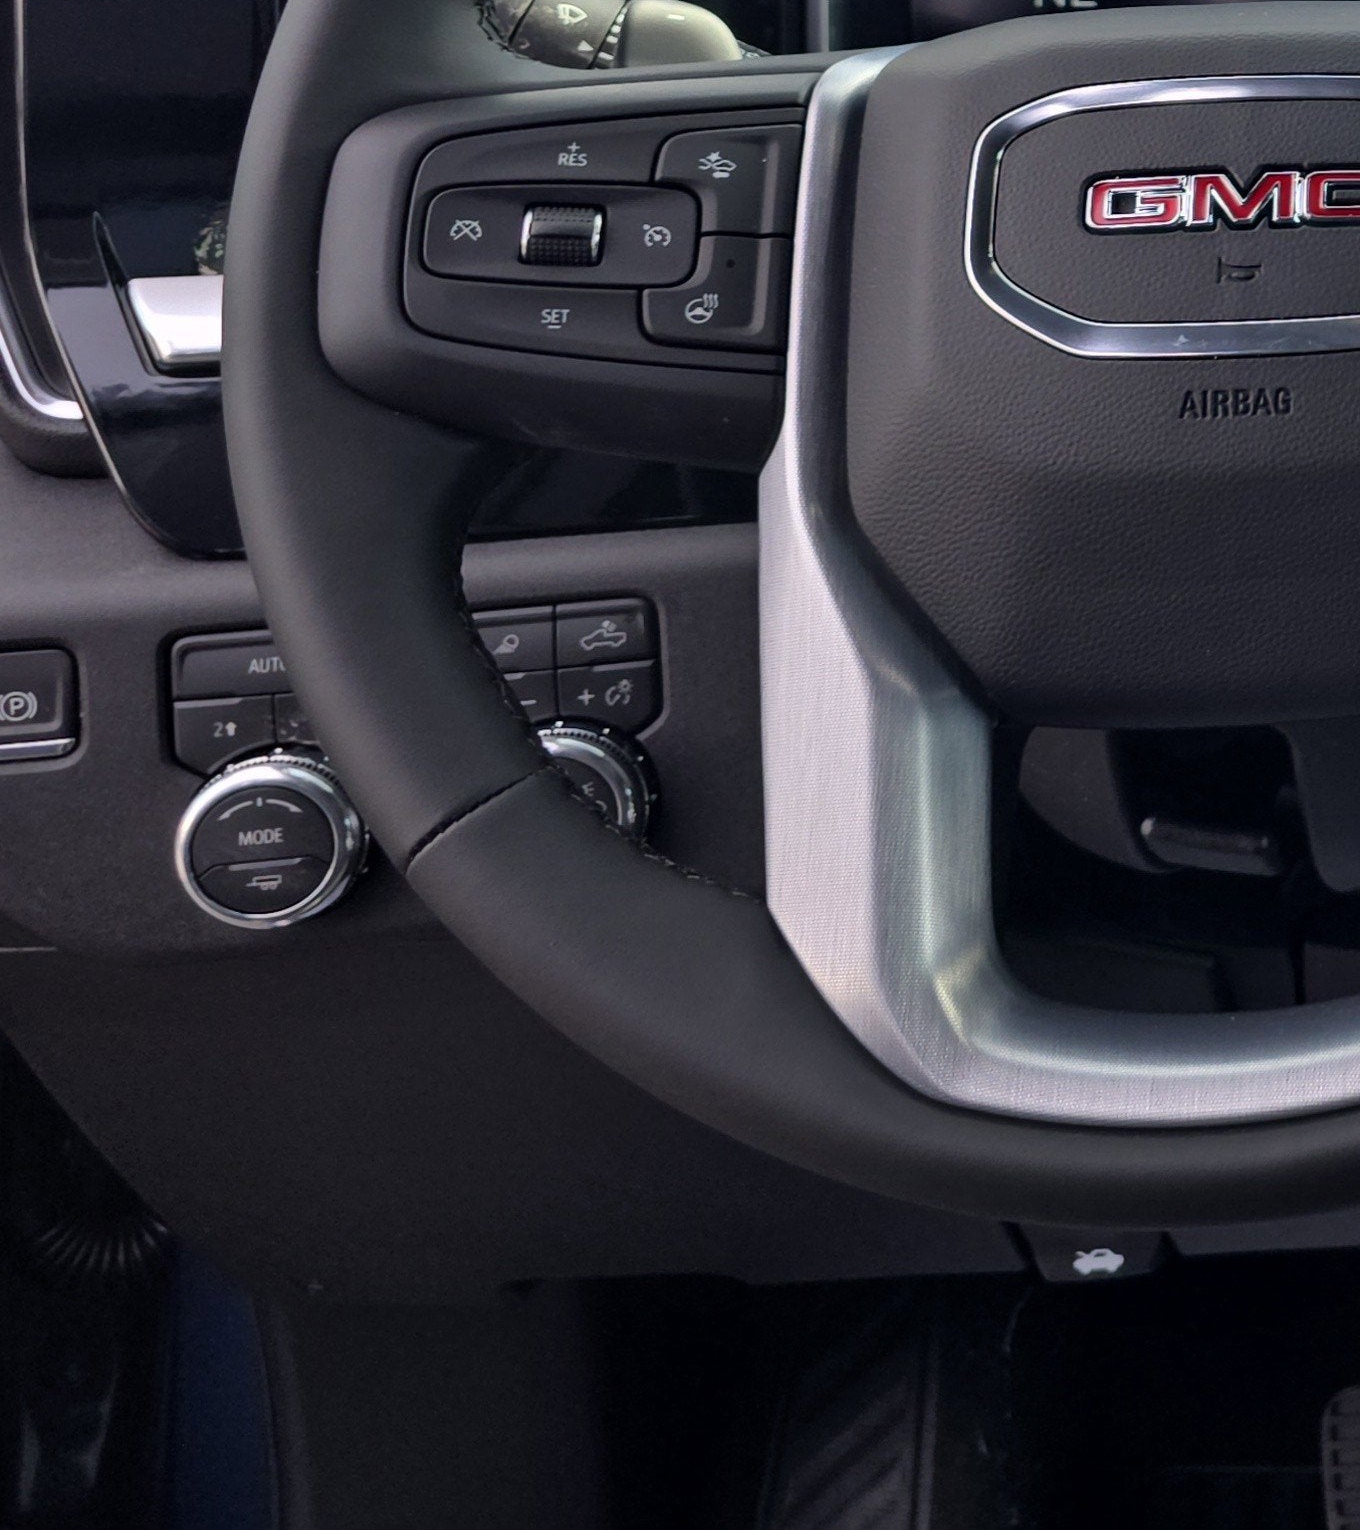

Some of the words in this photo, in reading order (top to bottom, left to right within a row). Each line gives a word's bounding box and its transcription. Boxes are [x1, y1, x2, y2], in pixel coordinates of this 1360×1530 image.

[558, 153, 587, 166] RES
[541, 308, 569, 325] SET
[1179, 388, 1292, 421] AIRBAG
[248, 656, 285, 674] AUT
[213, 722, 223, 737] 2
[238, 828, 284, 846] MODE
